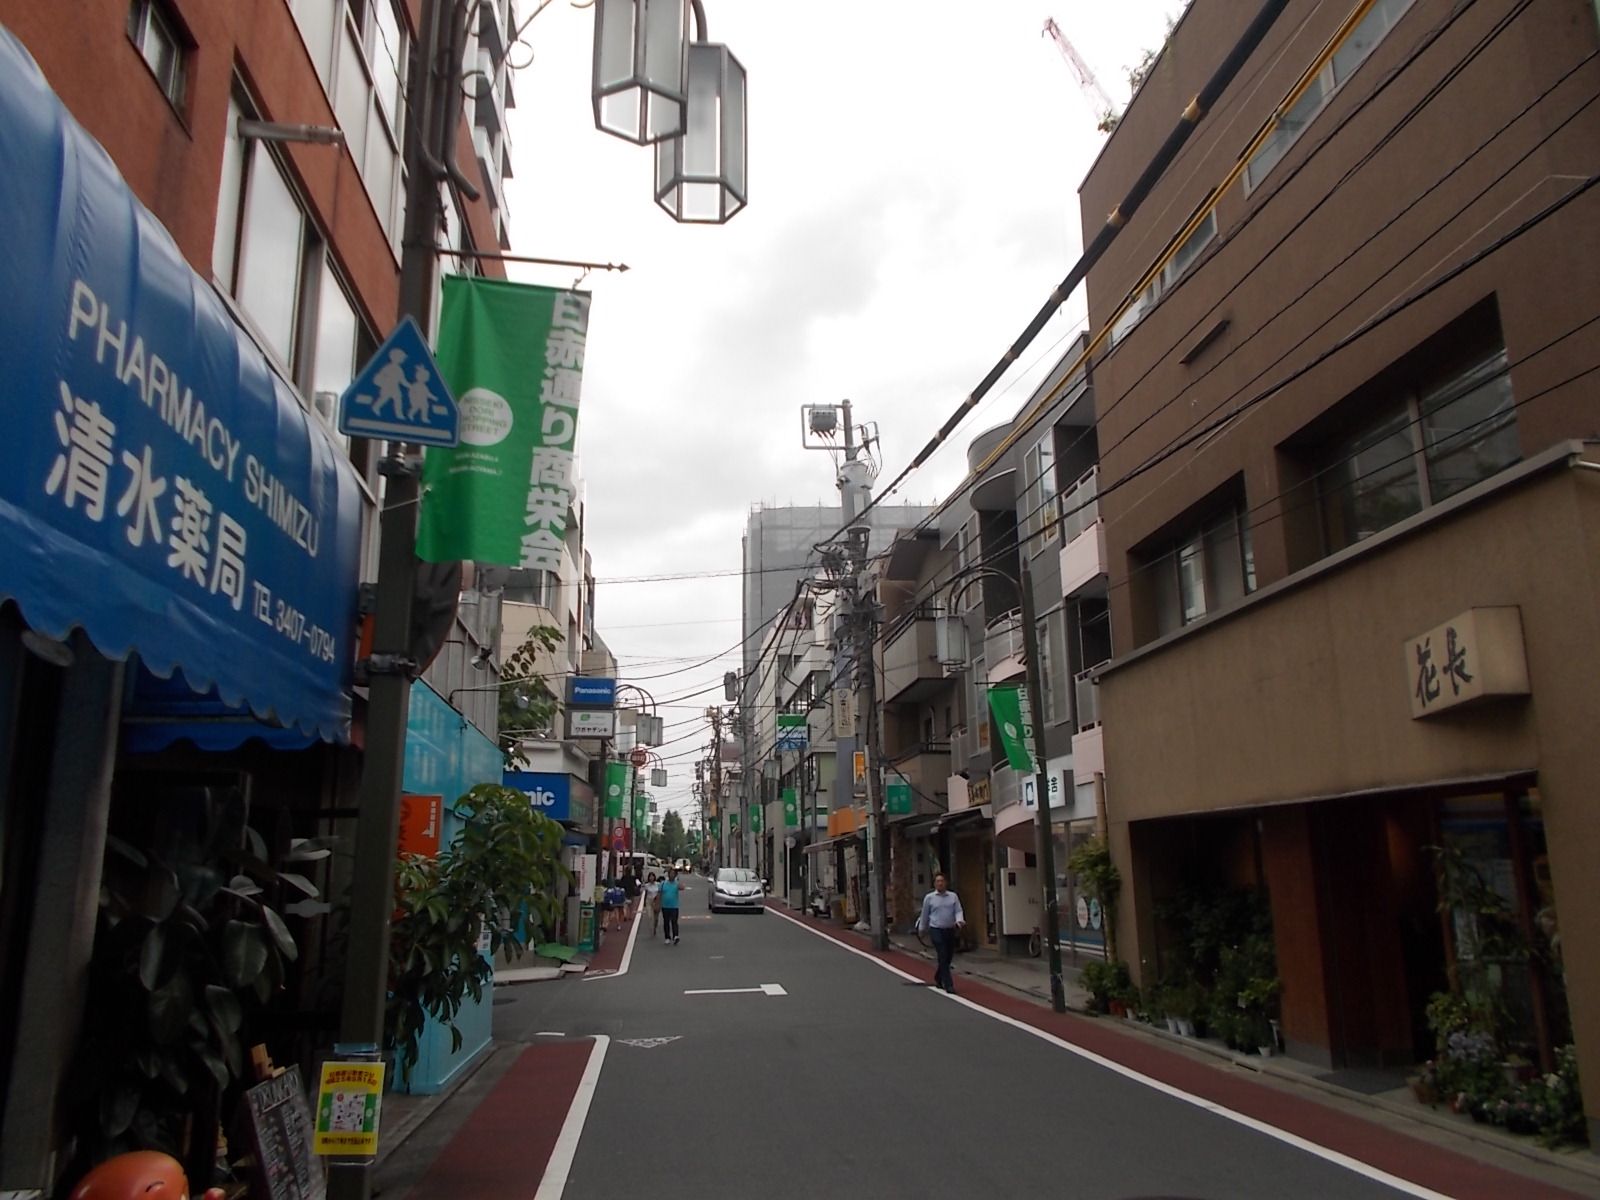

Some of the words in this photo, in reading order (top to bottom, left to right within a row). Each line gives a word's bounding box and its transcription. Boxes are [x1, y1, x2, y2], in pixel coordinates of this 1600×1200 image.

[45, 380, 247, 613] 清水薬局
[68, 279, 241, 484] PHARMACY
[245, 455, 319, 559] SHIMIZU
[253, 579, 273, 626] TEL
[276, 599, 335, 664] 3407-0794
[574, 687, 612, 695] Panasonic
